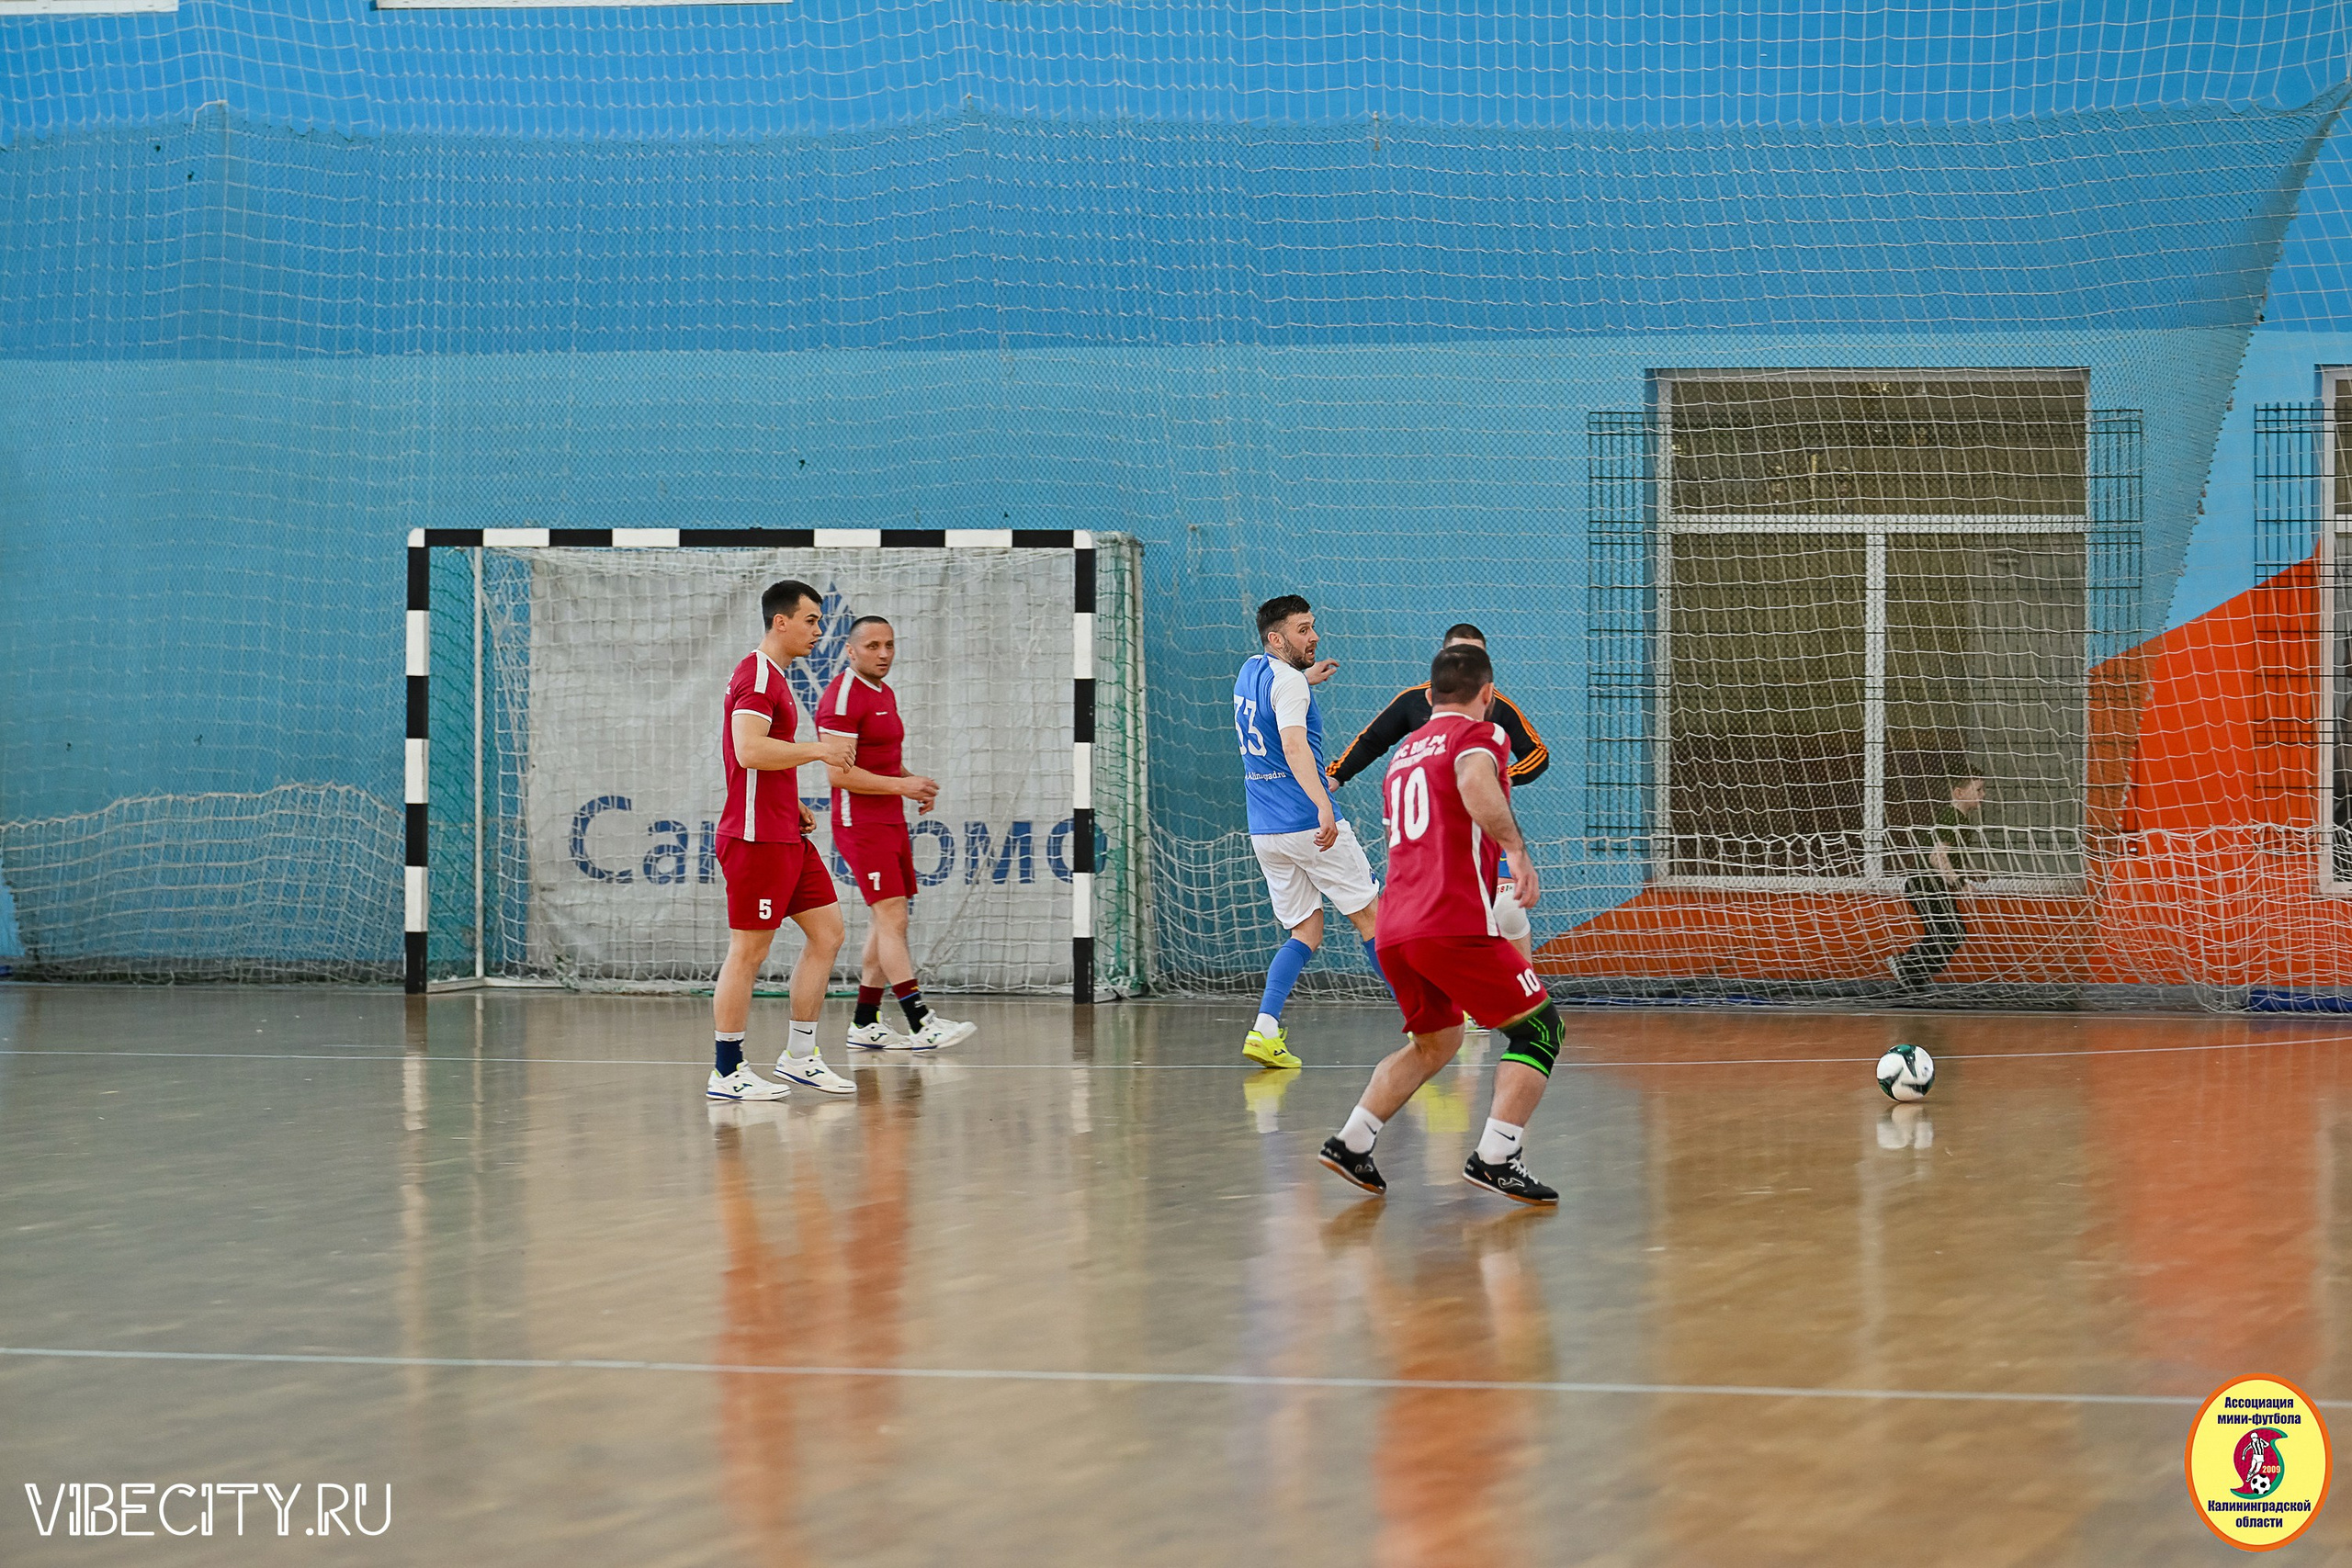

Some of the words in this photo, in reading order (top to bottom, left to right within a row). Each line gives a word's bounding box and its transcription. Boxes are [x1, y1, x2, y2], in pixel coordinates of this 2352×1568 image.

[1389, 766, 1430, 849] 10
[867, 872, 881, 891] 7
[759, 899, 772, 919] 5
[1516, 968, 1541, 998] 10
